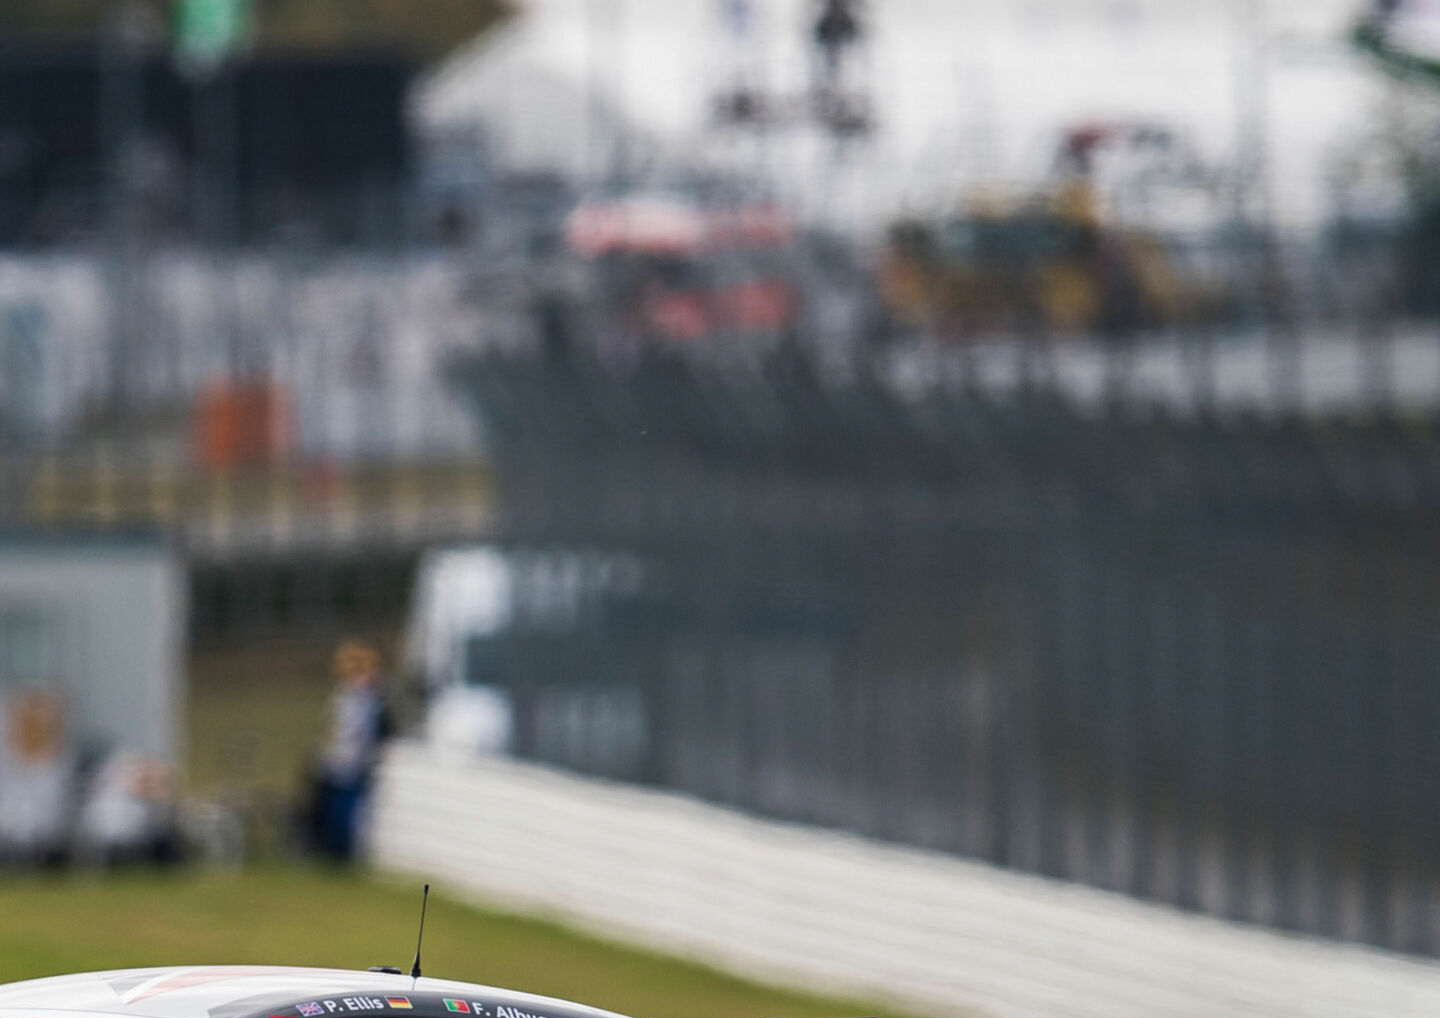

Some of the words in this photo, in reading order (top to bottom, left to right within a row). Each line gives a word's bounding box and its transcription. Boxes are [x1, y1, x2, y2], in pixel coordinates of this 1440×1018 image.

[324, 999, 343, 1014] P.
[348, 997, 384, 1011] Ellis
[472, 1002, 491, 1018] F.
